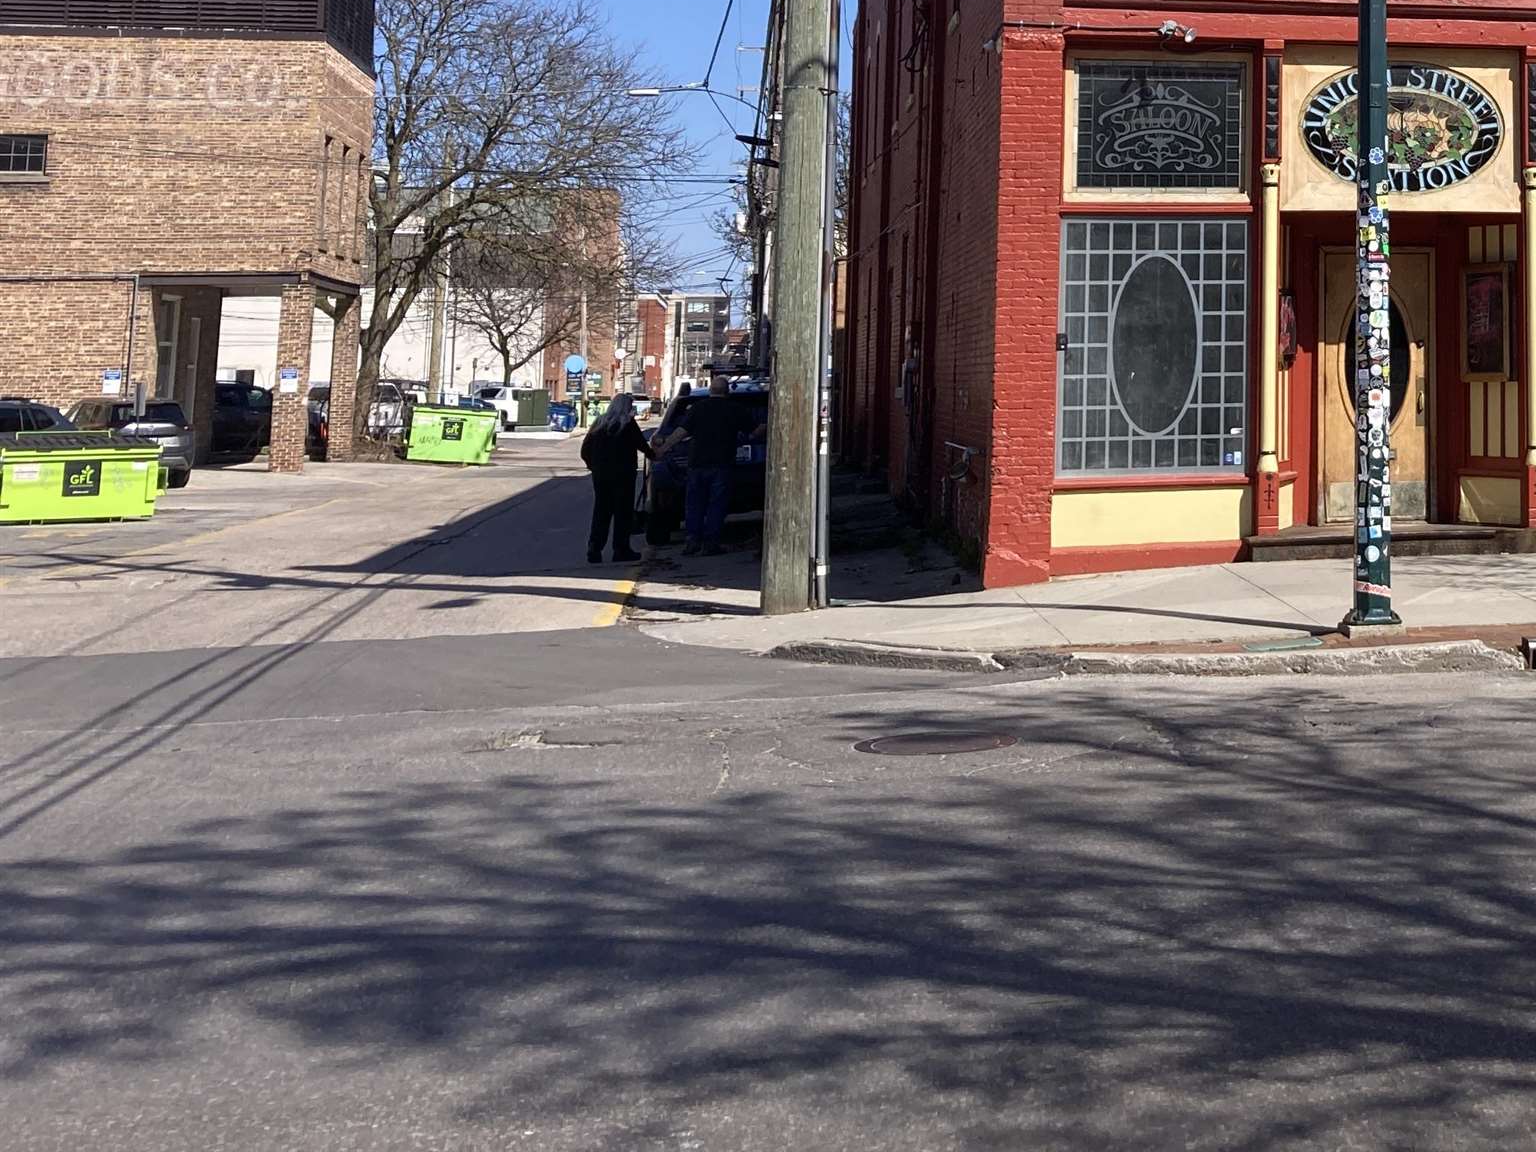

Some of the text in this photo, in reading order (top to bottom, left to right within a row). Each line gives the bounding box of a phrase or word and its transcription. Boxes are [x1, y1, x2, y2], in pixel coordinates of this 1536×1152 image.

[1302, 67, 1501, 137] UNI STREET
[1110, 106, 1213, 139] SALOON
[1333, 157, 1471, 193] STION
[69, 469, 94, 485] GFL
